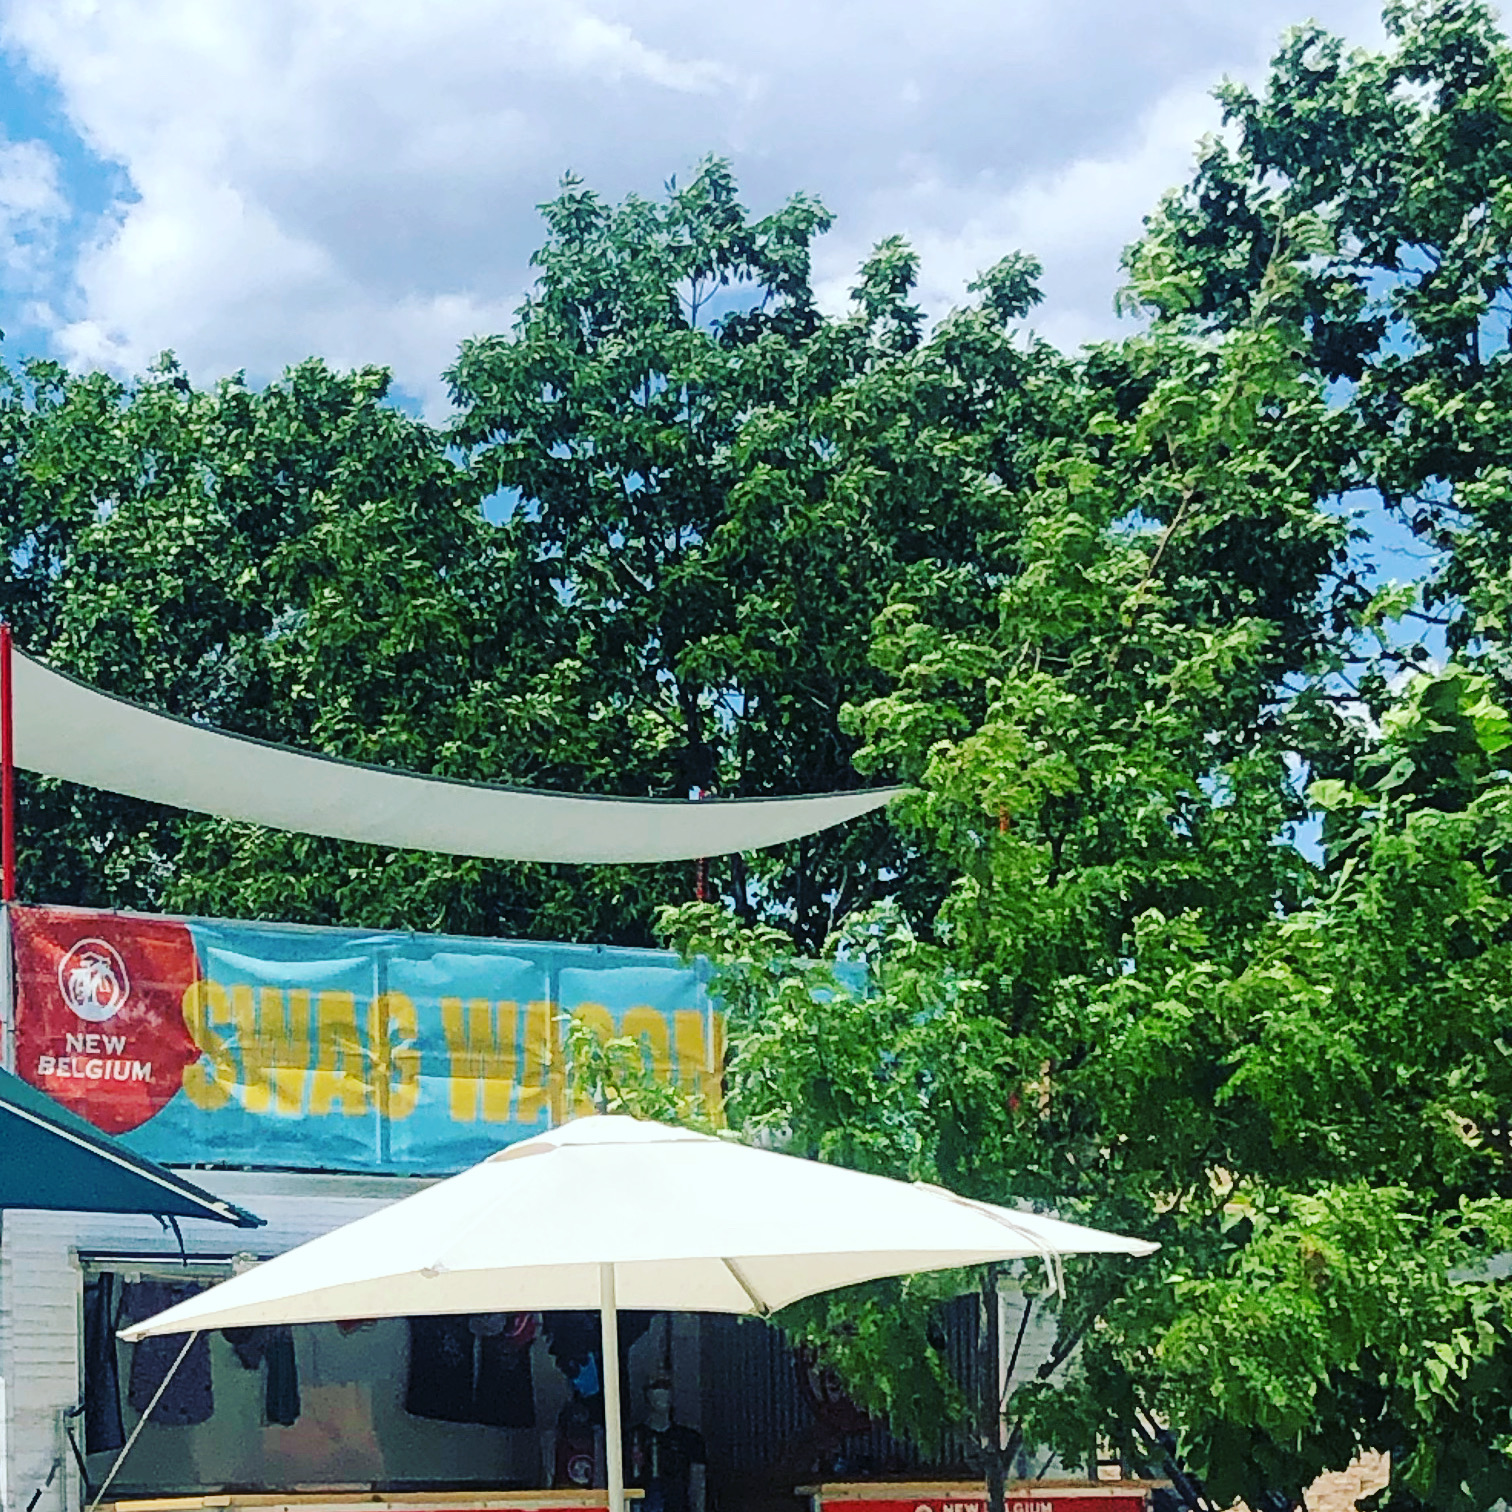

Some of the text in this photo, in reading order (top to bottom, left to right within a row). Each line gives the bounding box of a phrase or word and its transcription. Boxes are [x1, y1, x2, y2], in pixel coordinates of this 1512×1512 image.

[65, 1032, 127, 1056] NEW
[182, 979, 420, 1121] SWAG
[37, 1055, 152, 1083] BELGIUM
